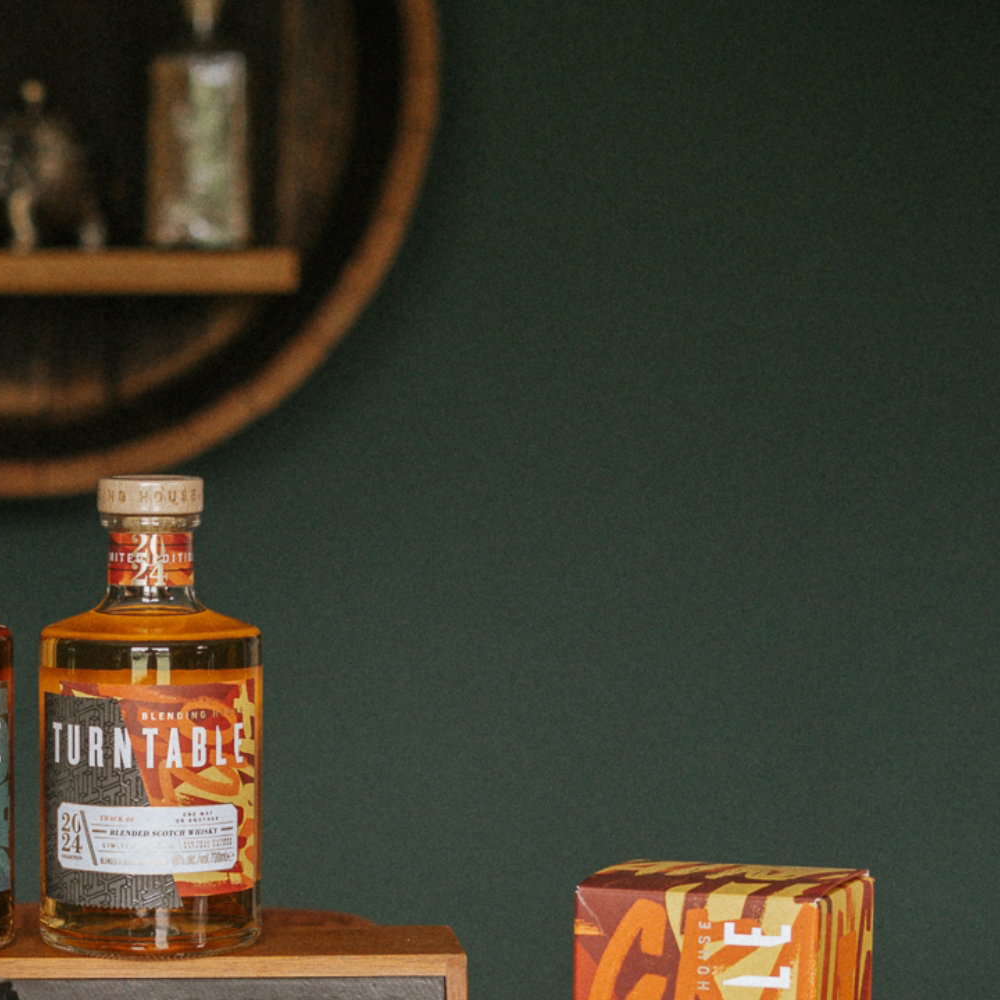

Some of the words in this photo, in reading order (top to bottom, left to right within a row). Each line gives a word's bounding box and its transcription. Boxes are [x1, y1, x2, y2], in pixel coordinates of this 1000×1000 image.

[141, 710, 208, 721] BLENDING
[52, 721, 245, 769] TURNTABLE
[61, 812, 82, 833] 20
[109, 829, 150, 838] BLENDED
[187, 827, 219, 836] WHISKY
[61, 833, 83, 854] 24
[696, 920, 712, 991] HOUSE
